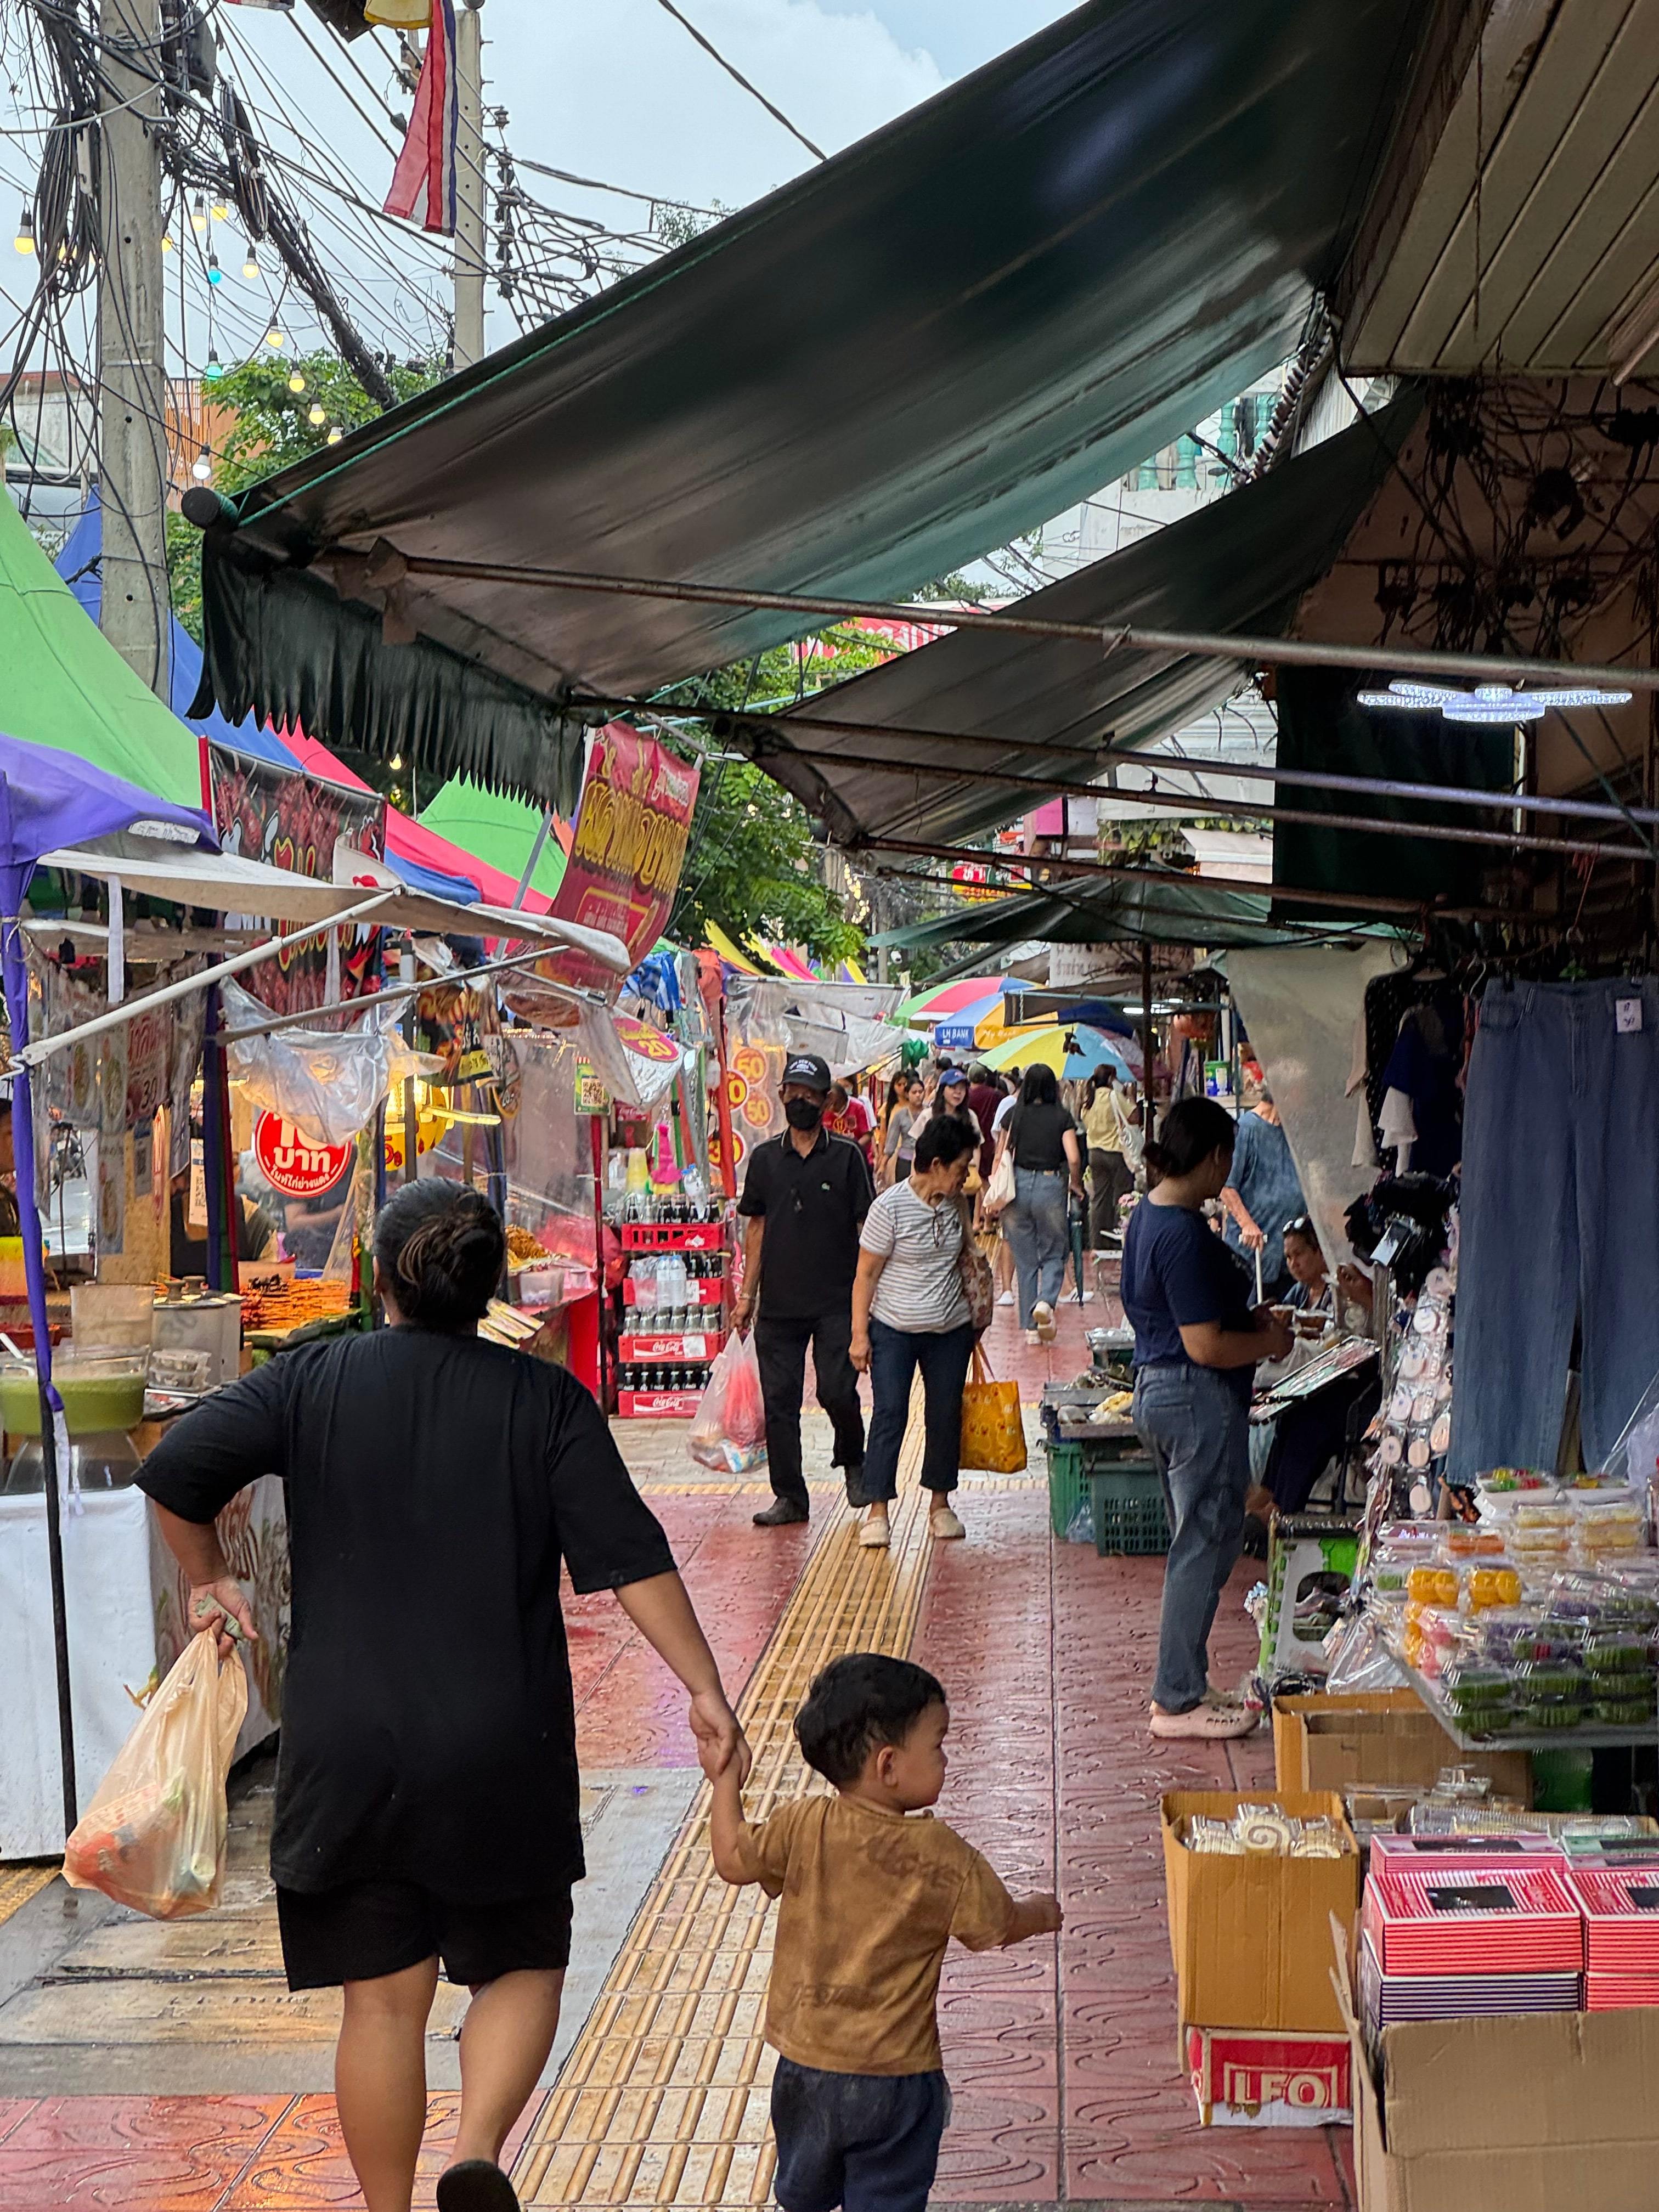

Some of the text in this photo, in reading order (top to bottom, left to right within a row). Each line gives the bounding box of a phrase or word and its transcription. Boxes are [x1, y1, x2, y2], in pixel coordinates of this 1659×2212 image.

[943, 1028, 969, 1039] LH BANK
[638, 1040, 672, 1057] 20
[737, 1057, 765, 1080] 50
[746, 1099, 770, 1123] 50
[273, 1147, 330, 1173] บาท
